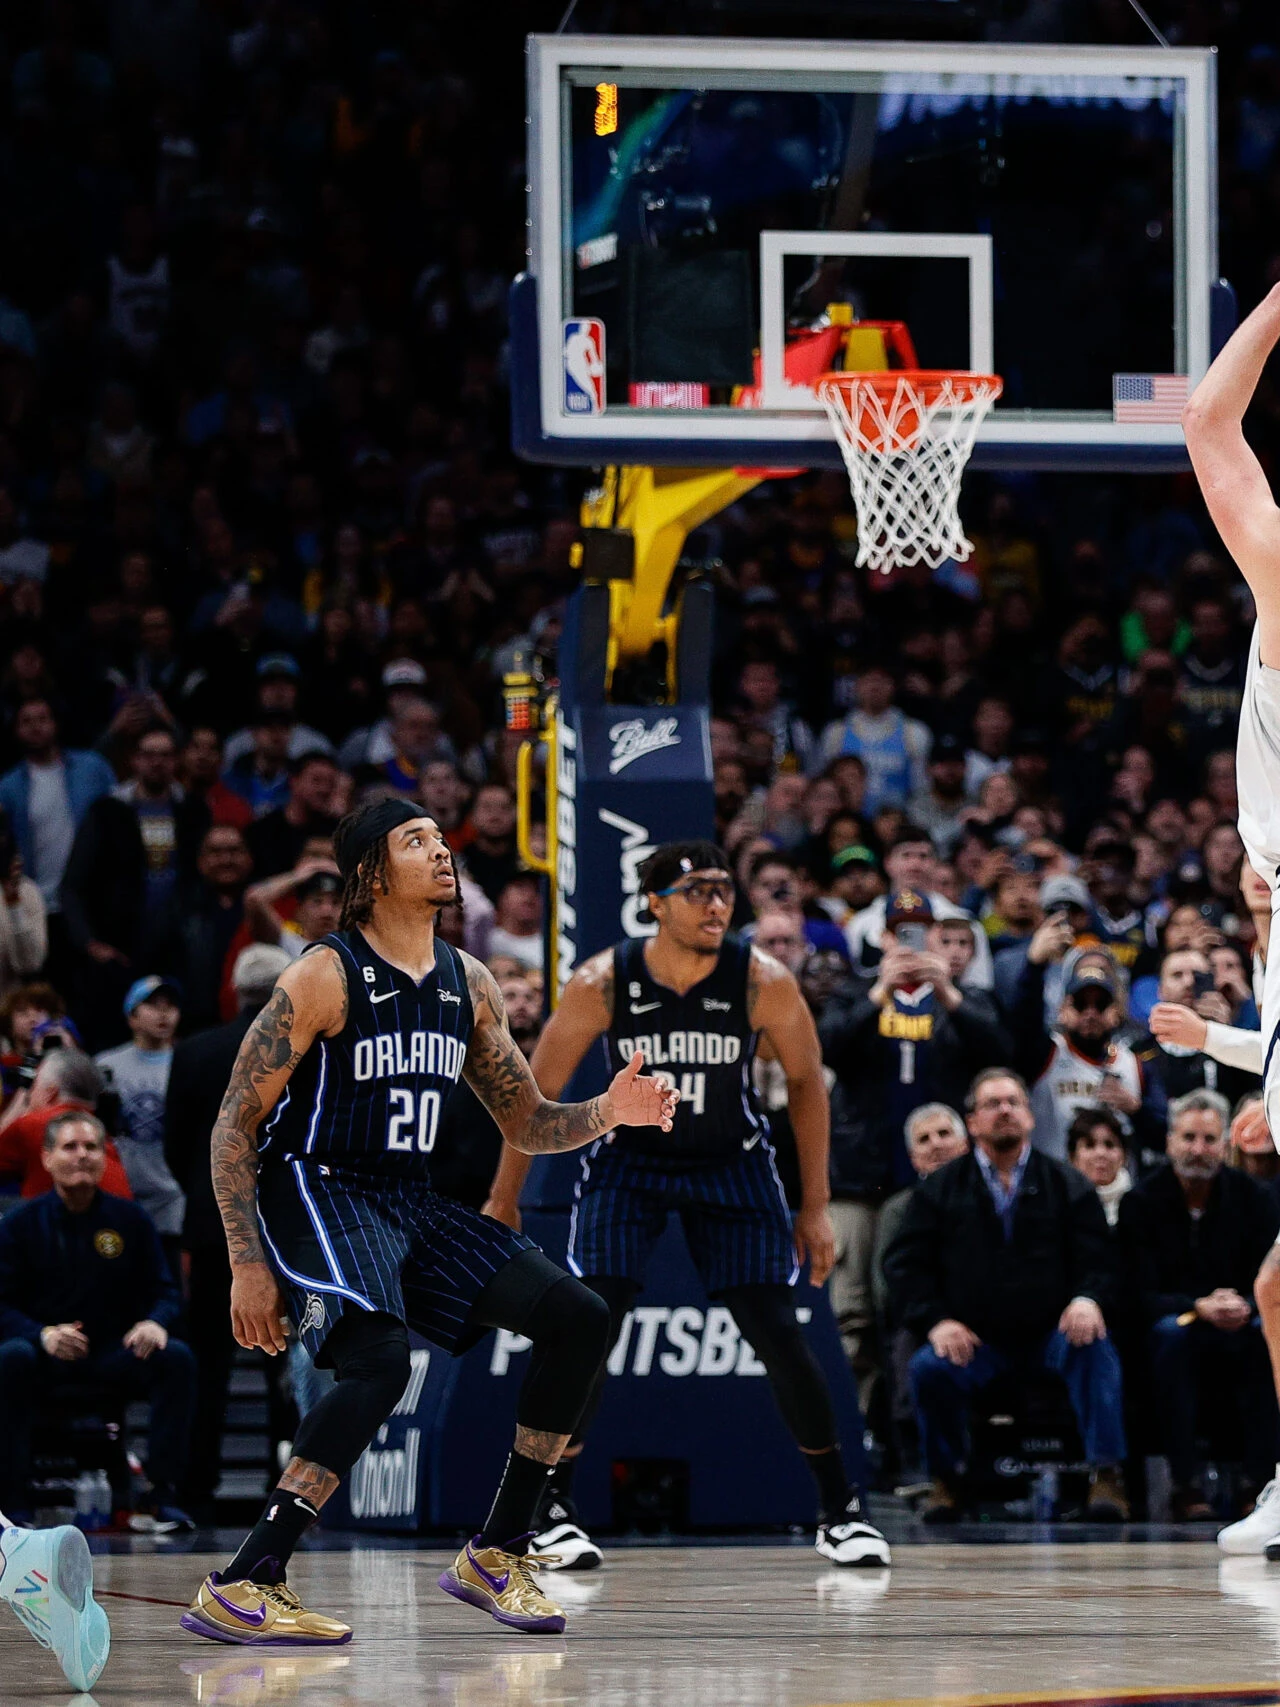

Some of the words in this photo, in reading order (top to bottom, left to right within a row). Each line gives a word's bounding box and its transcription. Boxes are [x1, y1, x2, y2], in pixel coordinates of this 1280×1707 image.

[608, 717, 682, 775] Ball
[556, 708, 577, 988] NTSBET
[362, 966, 376, 983] 6
[436, 988, 462, 1006] Disney
[354, 1031, 467, 1085] ORLANDO
[617, 1031, 741, 1065] ORLANDO
[387, 1087, 441, 1154] 20
